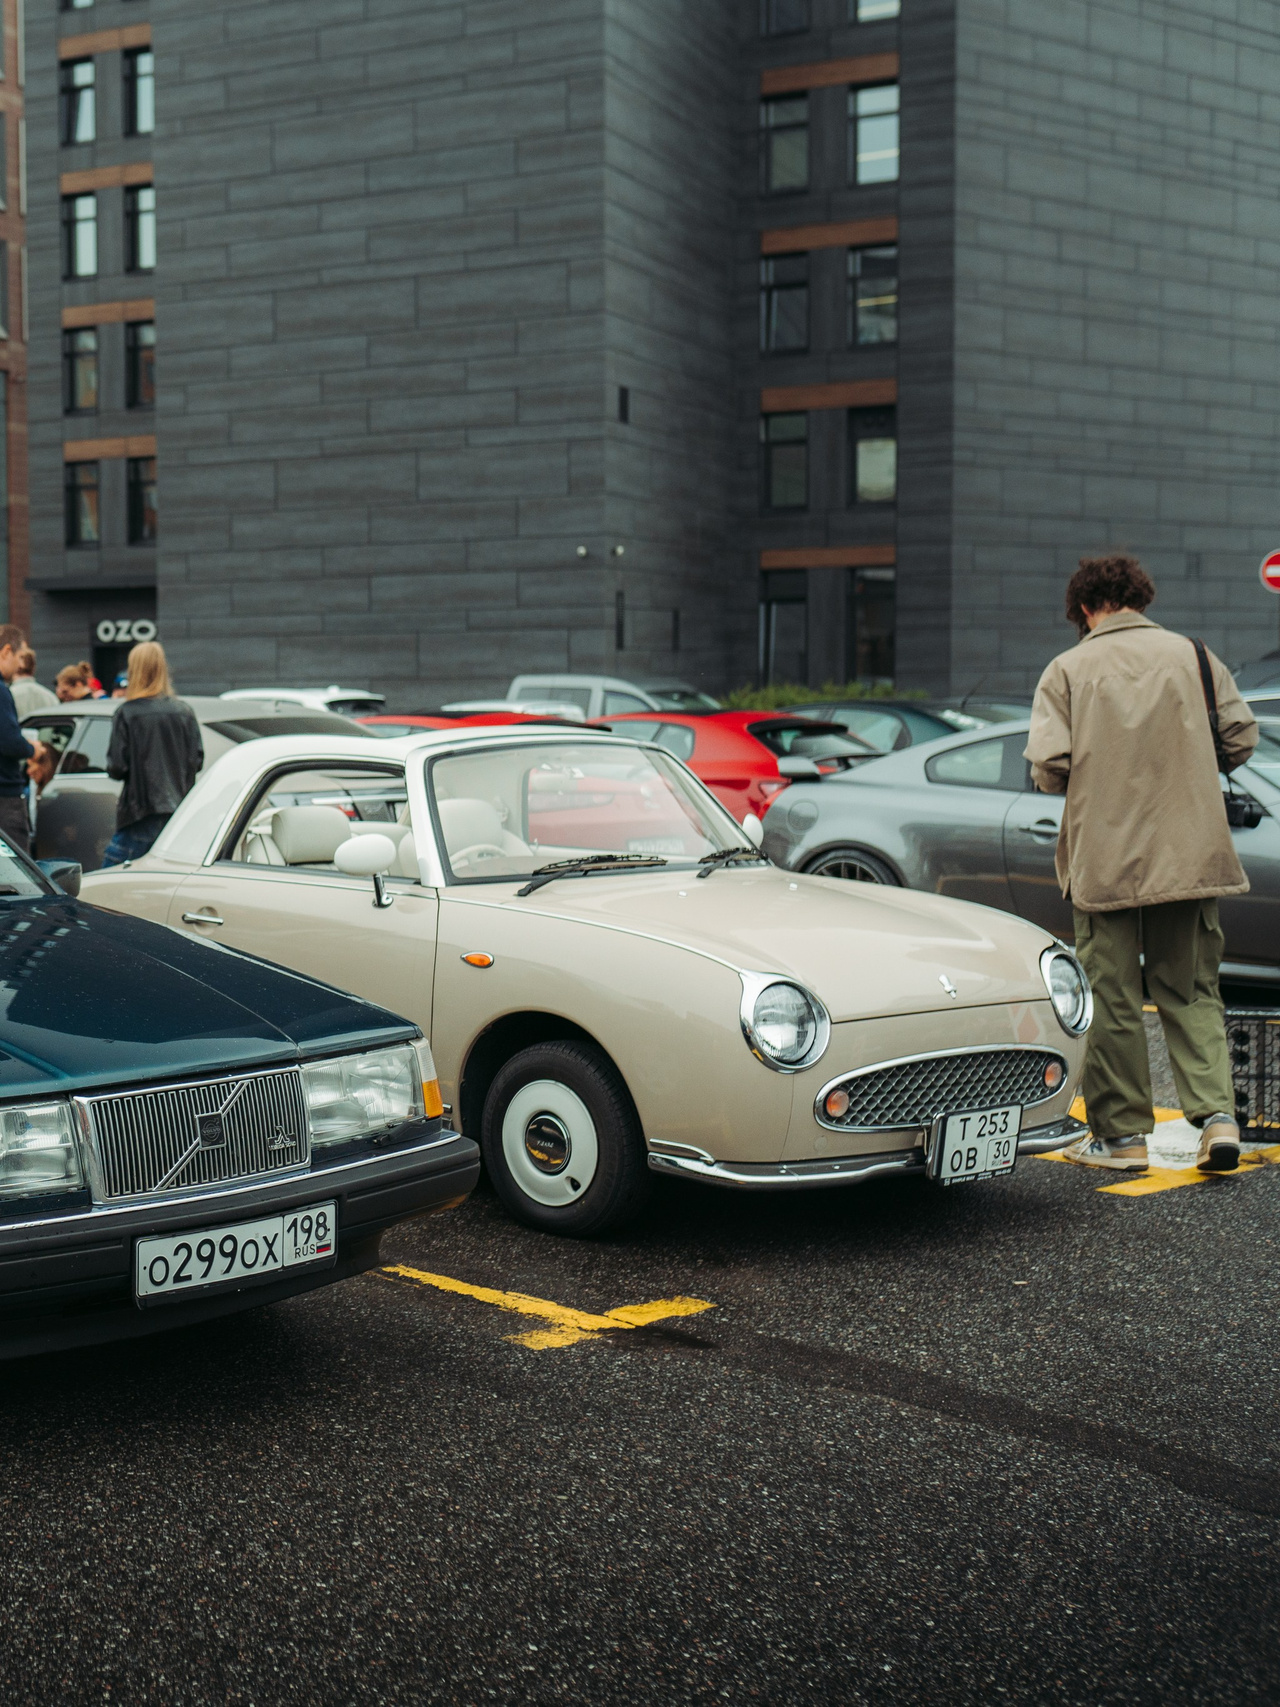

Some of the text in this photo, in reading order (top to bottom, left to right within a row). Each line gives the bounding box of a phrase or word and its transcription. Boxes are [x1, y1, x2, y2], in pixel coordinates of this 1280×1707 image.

[202, 1127, 221, 1135] VOLVO
[959, 1111, 1010, 1140] T 253
[950, 1147, 978, 1172] OB
[993, 1140, 1010, 1159] 30
[148, 1211, 328, 1287] O299OX 198
[294, 1243, 316, 1259] RUS
